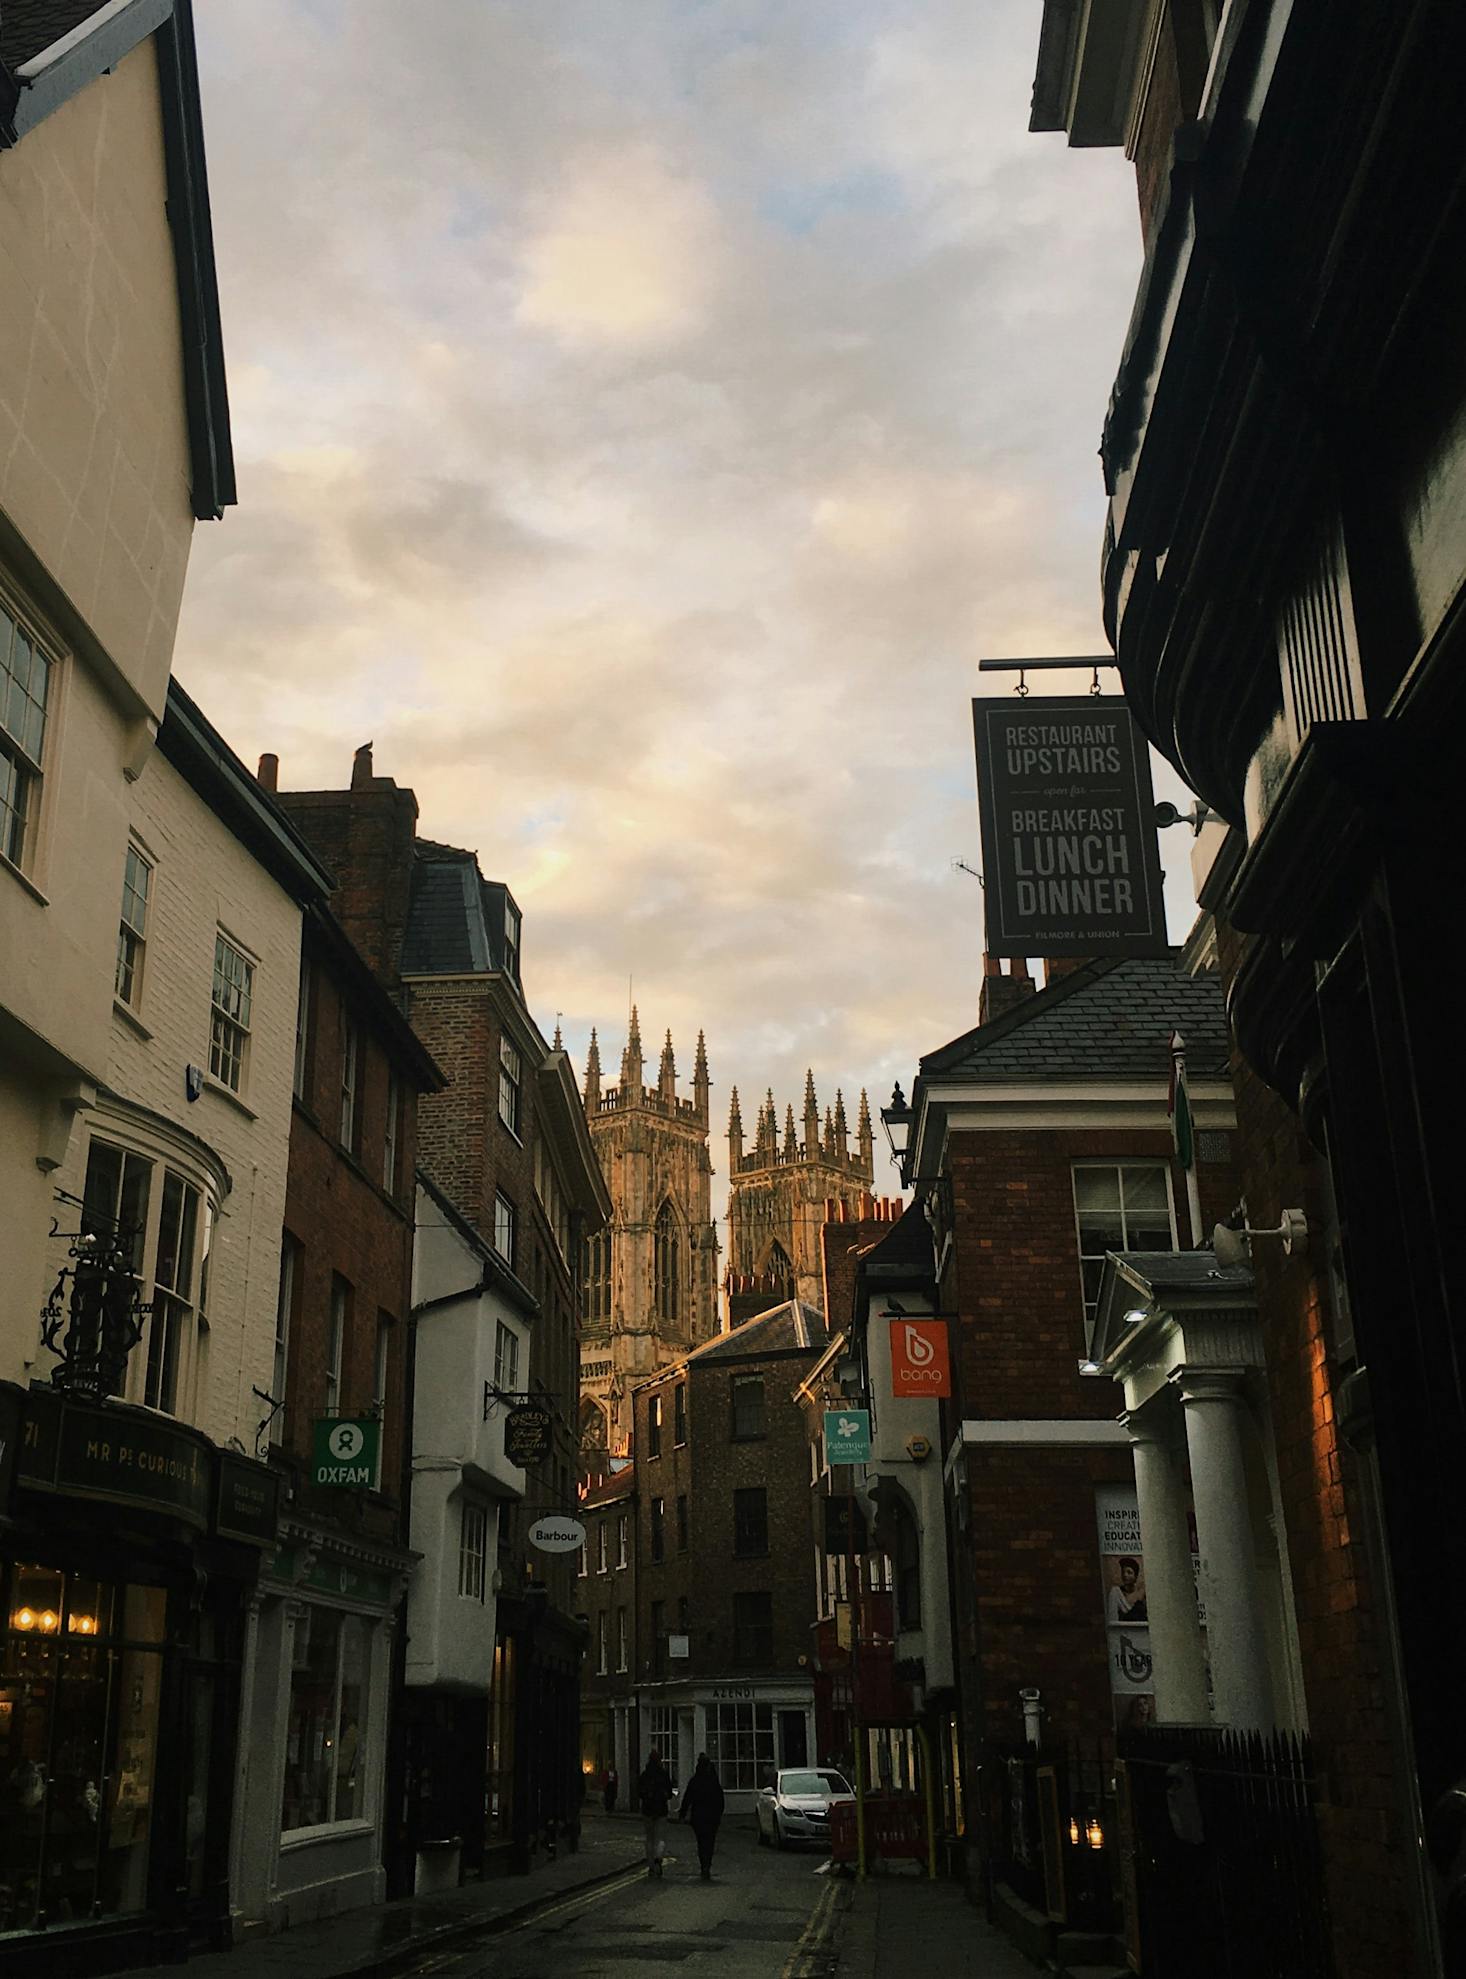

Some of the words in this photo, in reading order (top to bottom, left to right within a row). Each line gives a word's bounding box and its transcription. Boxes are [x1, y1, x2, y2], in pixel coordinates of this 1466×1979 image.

[1005, 724, 1117, 746] RESTAURANT
[1007, 746, 1121, 776] UPSTAIRS
[1043, 787, 1068, 799] open
[1011, 808, 1125, 833] BREAKFAST
[1013, 834, 1131, 877] LUNCH
[1017, 878, 1134, 917] DINNER
[1087, 929, 1120, 939] UNION
[900, 1367, 942, 1384] bang
[24, 1421, 39, 1449] 71
[86, 1439, 111, 1462] MR
[138, 1450, 187, 1481] CURIOUS
[317, 1466, 370, 1483] OXFAM
[1107, 1520, 1140, 1530] CREAT
[536, 1530, 578, 1541] Barbour
[1115, 1654, 1127, 1667] 10
[713, 1687, 755, 1698] AZENDI
